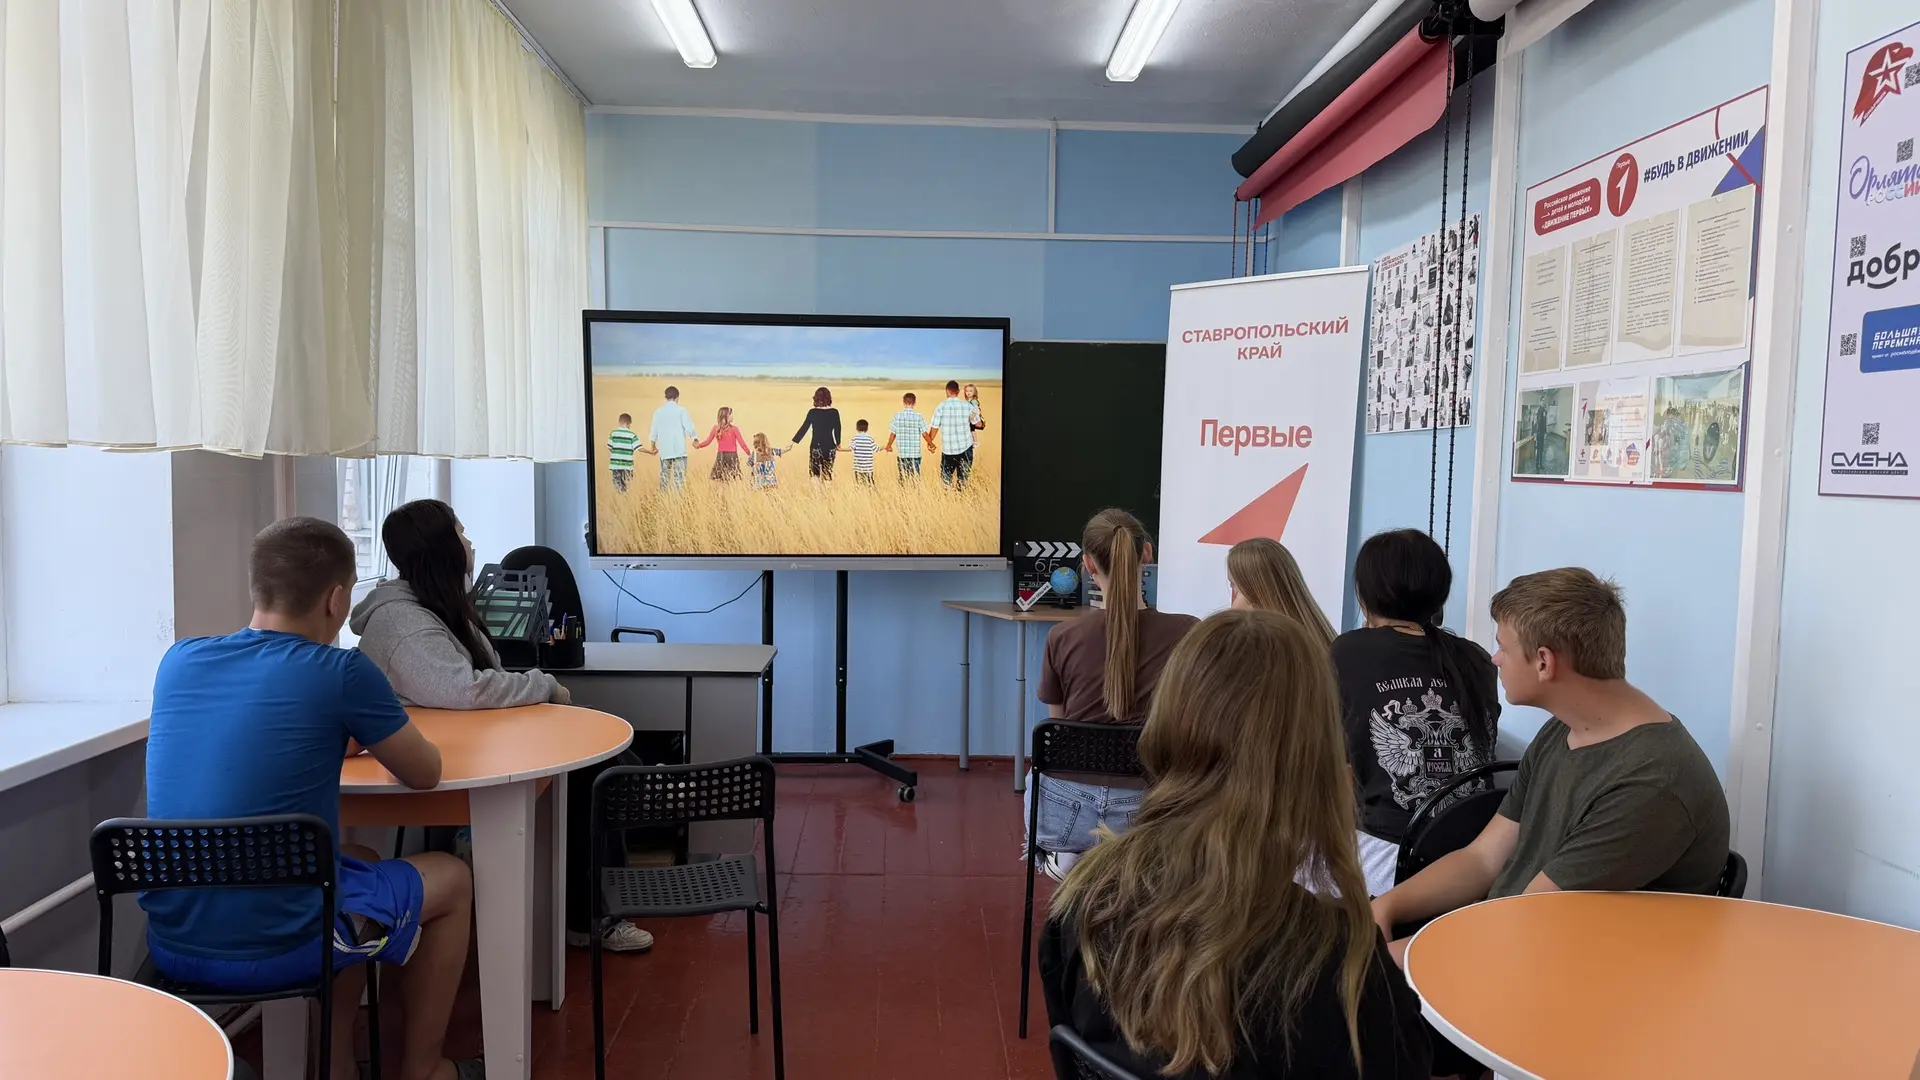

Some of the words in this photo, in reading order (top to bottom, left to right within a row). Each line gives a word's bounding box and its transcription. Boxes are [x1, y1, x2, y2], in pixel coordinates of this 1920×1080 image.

[1643, 159, 1675, 183] #БУДЬ
[1677, 155, 1684, 171] В
[1685, 129, 1749, 171] ДВИЖЕНИИ
[1181, 315, 1349, 344] СТАВРОПОЛЬСКИЙ
[1237, 341, 1282, 360] КРАЙ
[1200, 419, 1313, 456] Первые
[1831, 451, 1909, 467] СМЕНА
